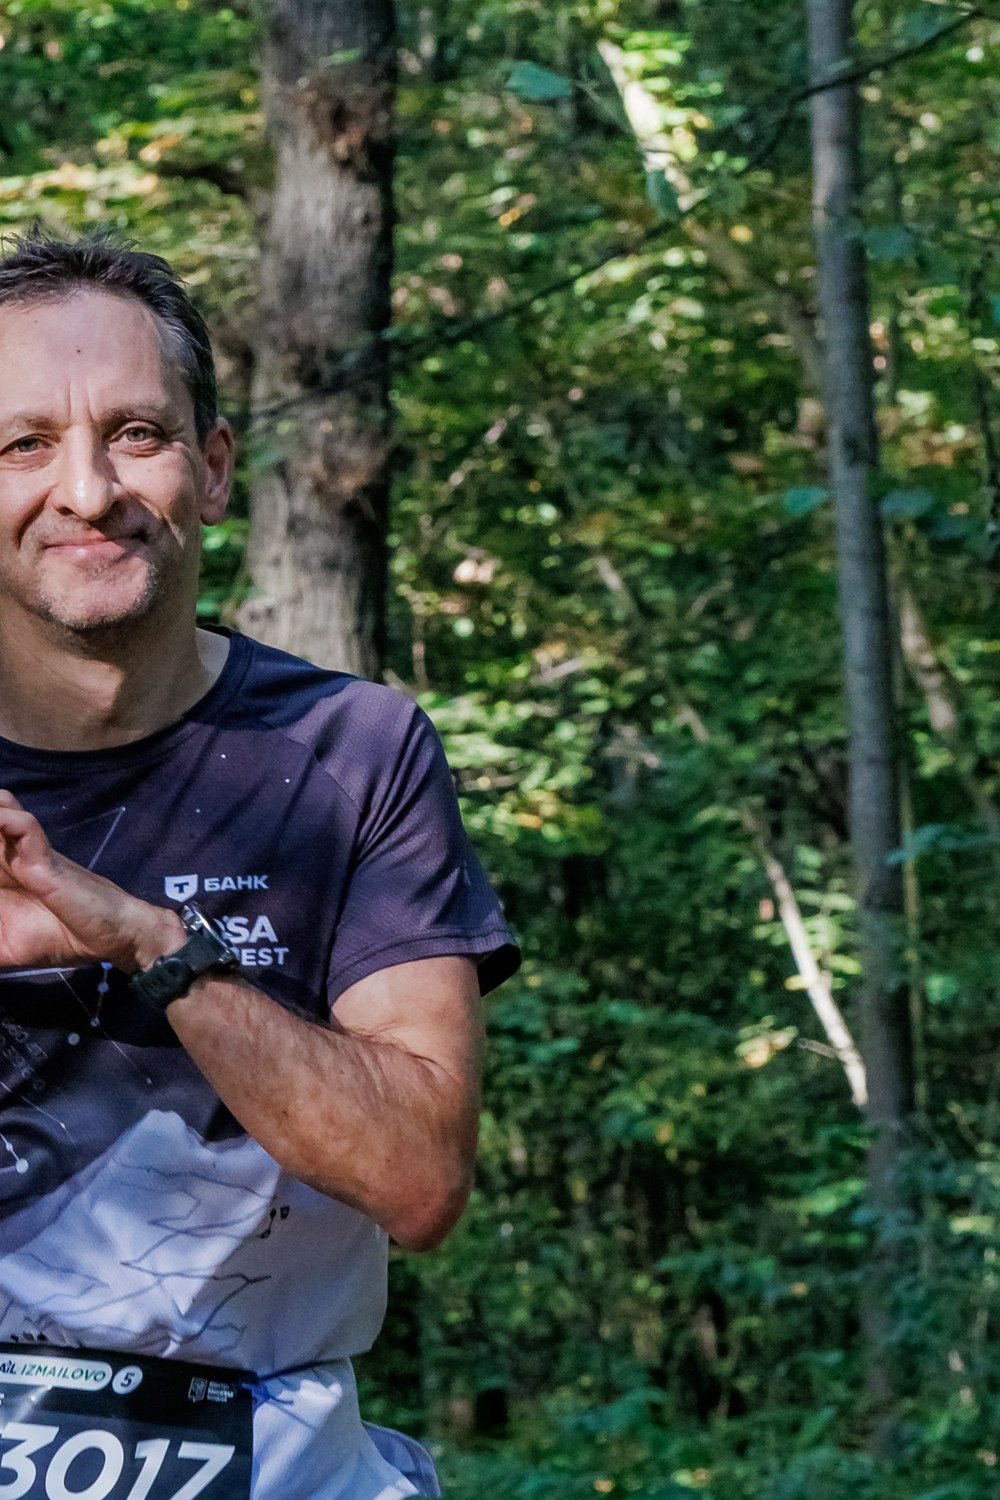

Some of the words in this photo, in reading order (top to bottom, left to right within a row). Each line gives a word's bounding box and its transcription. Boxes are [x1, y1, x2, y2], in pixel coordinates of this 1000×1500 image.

[204, 875, 269, 892] БАНК
[21, 1363, 106, 1382] IZMAILOVO
[120, 1372, 136, 1387] 5
